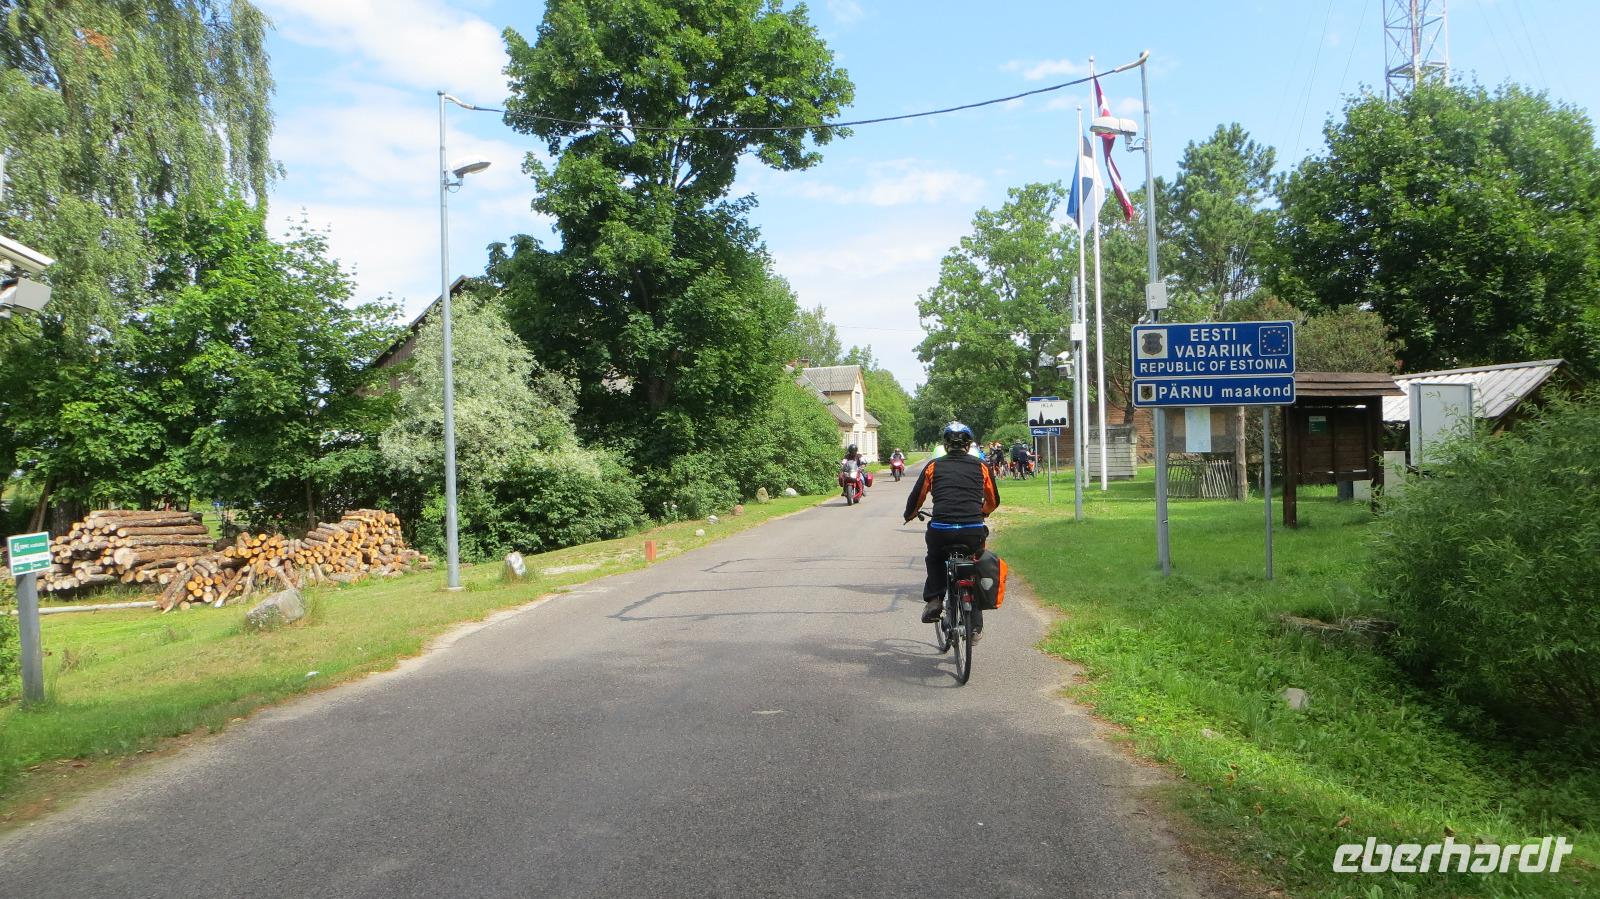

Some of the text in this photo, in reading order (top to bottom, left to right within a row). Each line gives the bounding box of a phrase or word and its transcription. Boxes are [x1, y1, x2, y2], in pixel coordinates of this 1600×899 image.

[1190, 327, 1236, 342] EESTI
[1175, 343, 1252, 358] VABARIIK
[1140, 358, 1288, 373] REPUBLIC OF ESTONIA
[1158, 383, 1291, 399] PÄRNU maakond
